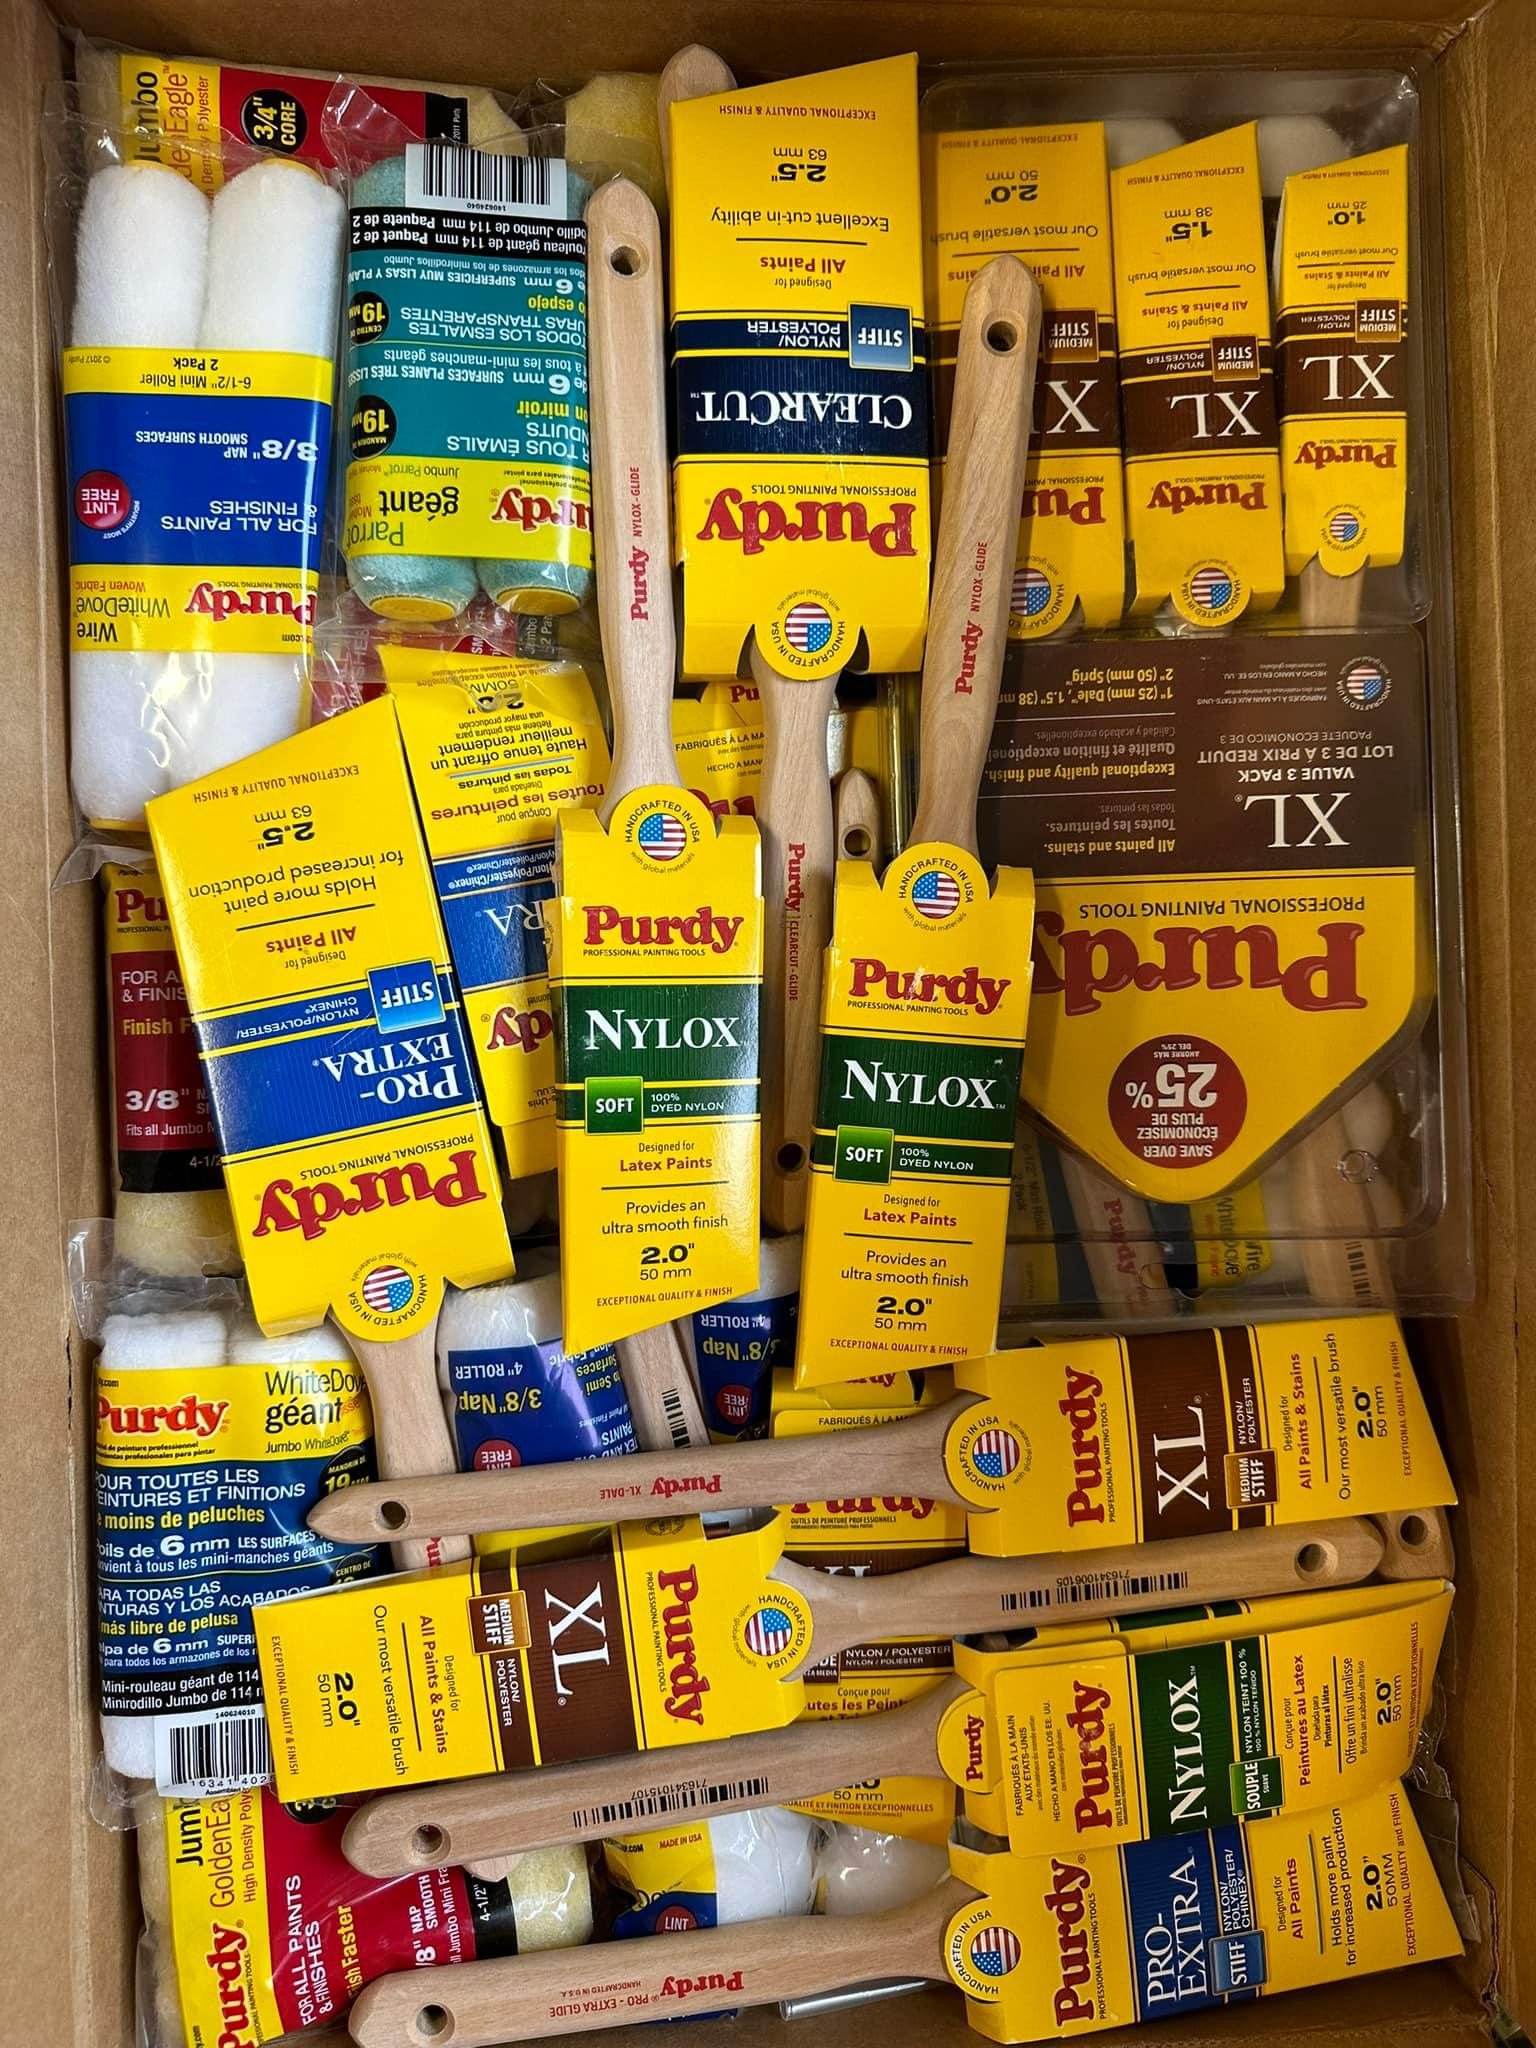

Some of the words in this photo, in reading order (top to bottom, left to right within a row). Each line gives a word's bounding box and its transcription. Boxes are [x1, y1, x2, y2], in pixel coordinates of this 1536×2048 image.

[253, 97, 278, 140] 3/4"
[719, 106, 751, 115] FINISH
[765, 107, 807, 117] QUALITY
[809, 108, 876, 120] EXCEPTIONAL
[281, 102, 296, 145] CORE
[773, 148, 802, 157] mm
[809, 150, 827, 159] 63
[772, 164, 826, 182] 2.5"
[985, 185, 1038, 205] 2.0"
[353, 215, 360, 225] 2
[364, 214, 379, 225] de
[384, 215, 435, 228] Paquete
[711, 207, 761, 225] ability
[767, 210, 812, 227] cut-in
[816, 213, 888, 232] Excellent
[1327, 212, 1366, 224] 1.0"
[383, 232, 428, 244] Paquet
[1166, 222, 1213, 242] 1.5"
[760, 257, 816, 272] Paints
[822, 259, 846, 272] All
[448, 274, 516, 286] SUPERFICIES
[529, 298, 574, 311] espejo
[401, 308, 538, 328] TRANSPARENTES
[409, 323, 495, 339] ESMALTES
[500, 327, 531, 341] LOS
[747, 321, 840, 334] POLYESTER
[858, 330, 903, 347] STIFF
[430, 352, 519, 366] mini-manches
[1218, 347, 1252, 359] STIFF
[173, 357, 205, 370] Pack
[210, 359, 218, 370] 2
[1218, 361, 1253, 370] MEDIUM
[140, 374, 176, 387] Roller
[180, 375, 207, 388] Mini
[211, 376, 251, 388] 6-1/2"
[1300, 354, 1395, 401] XL
[516, 401, 570, 417] miroir
[1166, 391, 1261, 438] XL
[136, 432, 196, 443] SURFACES
[199, 433, 248, 444] SMOOTH
[447, 436, 519, 456] ÉMAILS
[526, 441, 578, 460] TOUS
[81, 489, 119, 500] FREE
[752, 484, 786, 493] TOOLS
[788, 485, 835, 495] PAINTING
[837, 486, 916, 496] PROFESSIONAL
[379, 487, 459, 521] géant
[1148, 482, 1267, 514] Purdy
[84, 502, 117, 514] LINT
[210, 501, 297, 514] FINISHES
[161, 516, 230, 530] PAINTS
[237, 517, 272, 531] ALL
[696, 488, 917, 557] Purdy
[629, 546, 650, 621] Purdy
[520, 727, 572, 745] meilleur
[440, 737, 515, 756] rendement
[1263, 748, 1300, 761] PRIX
[1198, 751, 1258, 764] REDUIT
[1028, 765, 1051, 779] and
[1054, 764, 1099, 780] quality
[1102, 764, 1174, 778] Exceptional
[1238, 770, 1284, 781] PACK
[1288, 769, 1297, 780] 3
[1302, 767, 1354, 779] VALUE
[432, 797, 519, 820] peintures
[626, 800, 682, 843] HANDCRAFTED
[690, 822, 699, 843] USA
[258, 821, 314, 850] 2.5"
[1044, 842, 1085, 854] stains.
[1089, 841, 1112, 853] and
[1116, 840, 1155, 853] paints
[1159, 839, 1174, 851] All
[380, 850, 404, 865] for
[292, 855, 374, 880] increased
[189, 864, 285, 898] production
[326, 876, 376, 894] Holds
[225, 887, 268, 914] paint
[274, 885, 320, 901] more
[1080, 904, 1138, 919] TOOLS
[1142, 901, 1225, 917] PAINTING
[1232, 896, 1364, 914] PROFESSIONAL
[583, 905, 744, 954] Purdy
[381, 981, 433, 1008] STIFF
[849, 958, 1011, 1015] Purdy
[123, 1018, 172, 1035] Finish
[360, 1064, 463, 1104] PRO-
[1125, 1063, 1218, 1109] 25%
[596, 1098, 634, 1113] SOFT
[651, 1093, 680, 1101] 100%
[651, 1103, 682, 1112] DYED
[685, 1102, 724, 1111] NYLON
[1137, 1128, 1218, 1140] ÉCONOMISEZ
[1143, 1146, 1176, 1158] OVER
[1180, 1145, 1212, 1157] SAVE
[620, 1158, 662, 1171] Latex
[666, 1157, 712, 1169] Paints
[253, 1151, 487, 1240] Purdy
[627, 1201, 686, 1214] Provides
[690, 1201, 705, 1210] an
[602, 1221, 633, 1235] ultra
[637, 1220, 690, 1232] smooth
[694, 1216, 728, 1229] finish
[641, 1243, 695, 1265] 2.0"
[640, 1269, 659, 1280] 50
[663, 1268, 691, 1278] mm
[877, 1296, 932, 1316] 2.0"
[456, 1364, 505, 1380] ROLLER
[508, 1362, 523, 1376] 4"
[460, 1391, 496, 1414] Nap
[499, 1388, 542, 1415] 3/8"
[265, 1397, 343, 1434] géant
[1352, 1386, 1374, 1439] 2.0"
[1058, 1366, 1104, 1528] Purdy
[138, 1470, 218, 1489] TOUTES
[225, 1469, 259, 1483] LES
[650, 1474, 722, 1498] Purdy
[1252, 1459, 1265, 1497] STIFF
[187, 1489, 212, 1503] ET
[217, 1483, 305, 1501] FINITIONS
[105, 1509, 154, 1530] moins
[188, 1505, 265, 1529] peluches
[127, 1586, 183, 1601] TODAS
[189, 1581, 221, 1596] LAS
[130, 1618, 163, 1635] libre
[168, 1617, 187, 1633] de
[191, 1613, 238, 1630] pelusa
[374, 1606, 387, 1628] Our
[483, 1604, 501, 1645] STIFF
[499, 1599, 514, 1645] MEDIUM
[658, 1564, 710, 1725] Purdy
[377, 1635, 392, 1674] most
[508, 1659, 520, 1703] NYLON/
[1294, 1655, 1305, 1696] Latex
[334, 1672, 360, 1726] 2.0"
[496, 1661, 512, 1726] POLYESTER
[383, 1676, 399, 1734] versatile
[1298, 1698, 1307, 1715] au
[392, 1737, 409, 1775] brush
[1067, 1680, 1112, 1833] Purdy
[1298, 1719, 1311, 1786] Peintures
[631, 1779, 708, 1800] 716341015107
[1246, 1762, 1261, 1810] SOUPLE
[659, 1837, 679, 1849] MADE
[680, 1836, 688, 1845] IN
[689, 1833, 702, 1844] USA
[1383, 1853, 1397, 1907] 50MM
[285, 1875, 302, 1952] PAINTS
[665, 1917, 689, 1930] LINT
[1170, 1856, 1207, 2001] EXTRA
[337, 1905, 355, 1970] Faster
[1044, 1858, 1094, 2027] Purdy
[1144, 1913, 1177, 2006] PRO-
[1231, 1942, 1247, 1984] STIFF
[660, 1971, 745, 1998] Purdy
